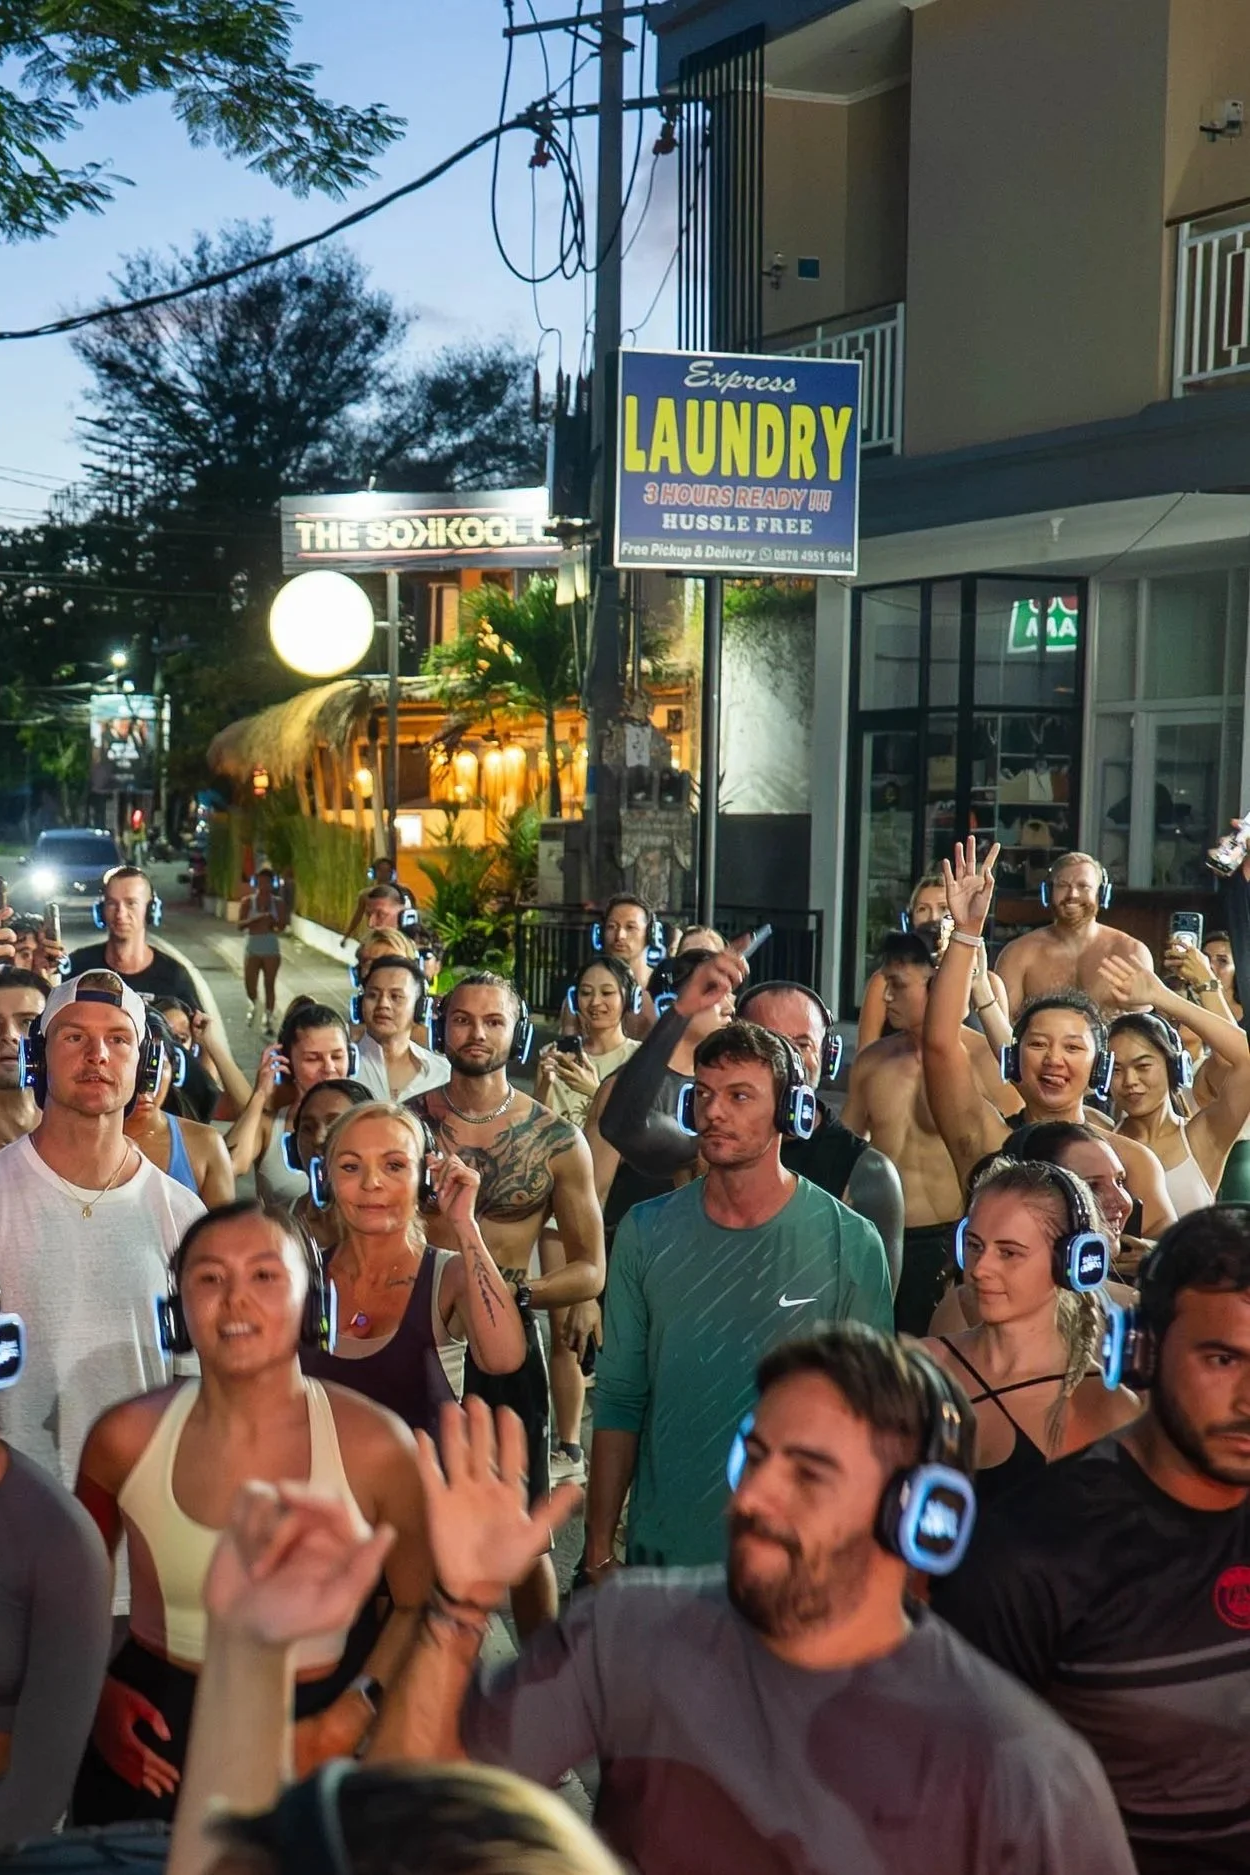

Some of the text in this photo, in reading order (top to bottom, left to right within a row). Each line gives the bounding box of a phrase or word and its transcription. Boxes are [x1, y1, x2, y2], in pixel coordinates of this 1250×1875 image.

[683, 360, 797, 394] Express
[624, 395, 853, 481] LAUNDRY
[643, 482, 659, 505] 3
[659, 483, 734, 508] HOURS
[734, 485, 808, 511] READY
[295, 521, 359, 550] THE
[662, 513, 813, 535] HUSSLE FREE
[620, 542, 649, 556] Free
[651, 543, 692, 560] Pickup
[693, 545, 702, 559] &
[705, 545, 754, 563] Delivery
